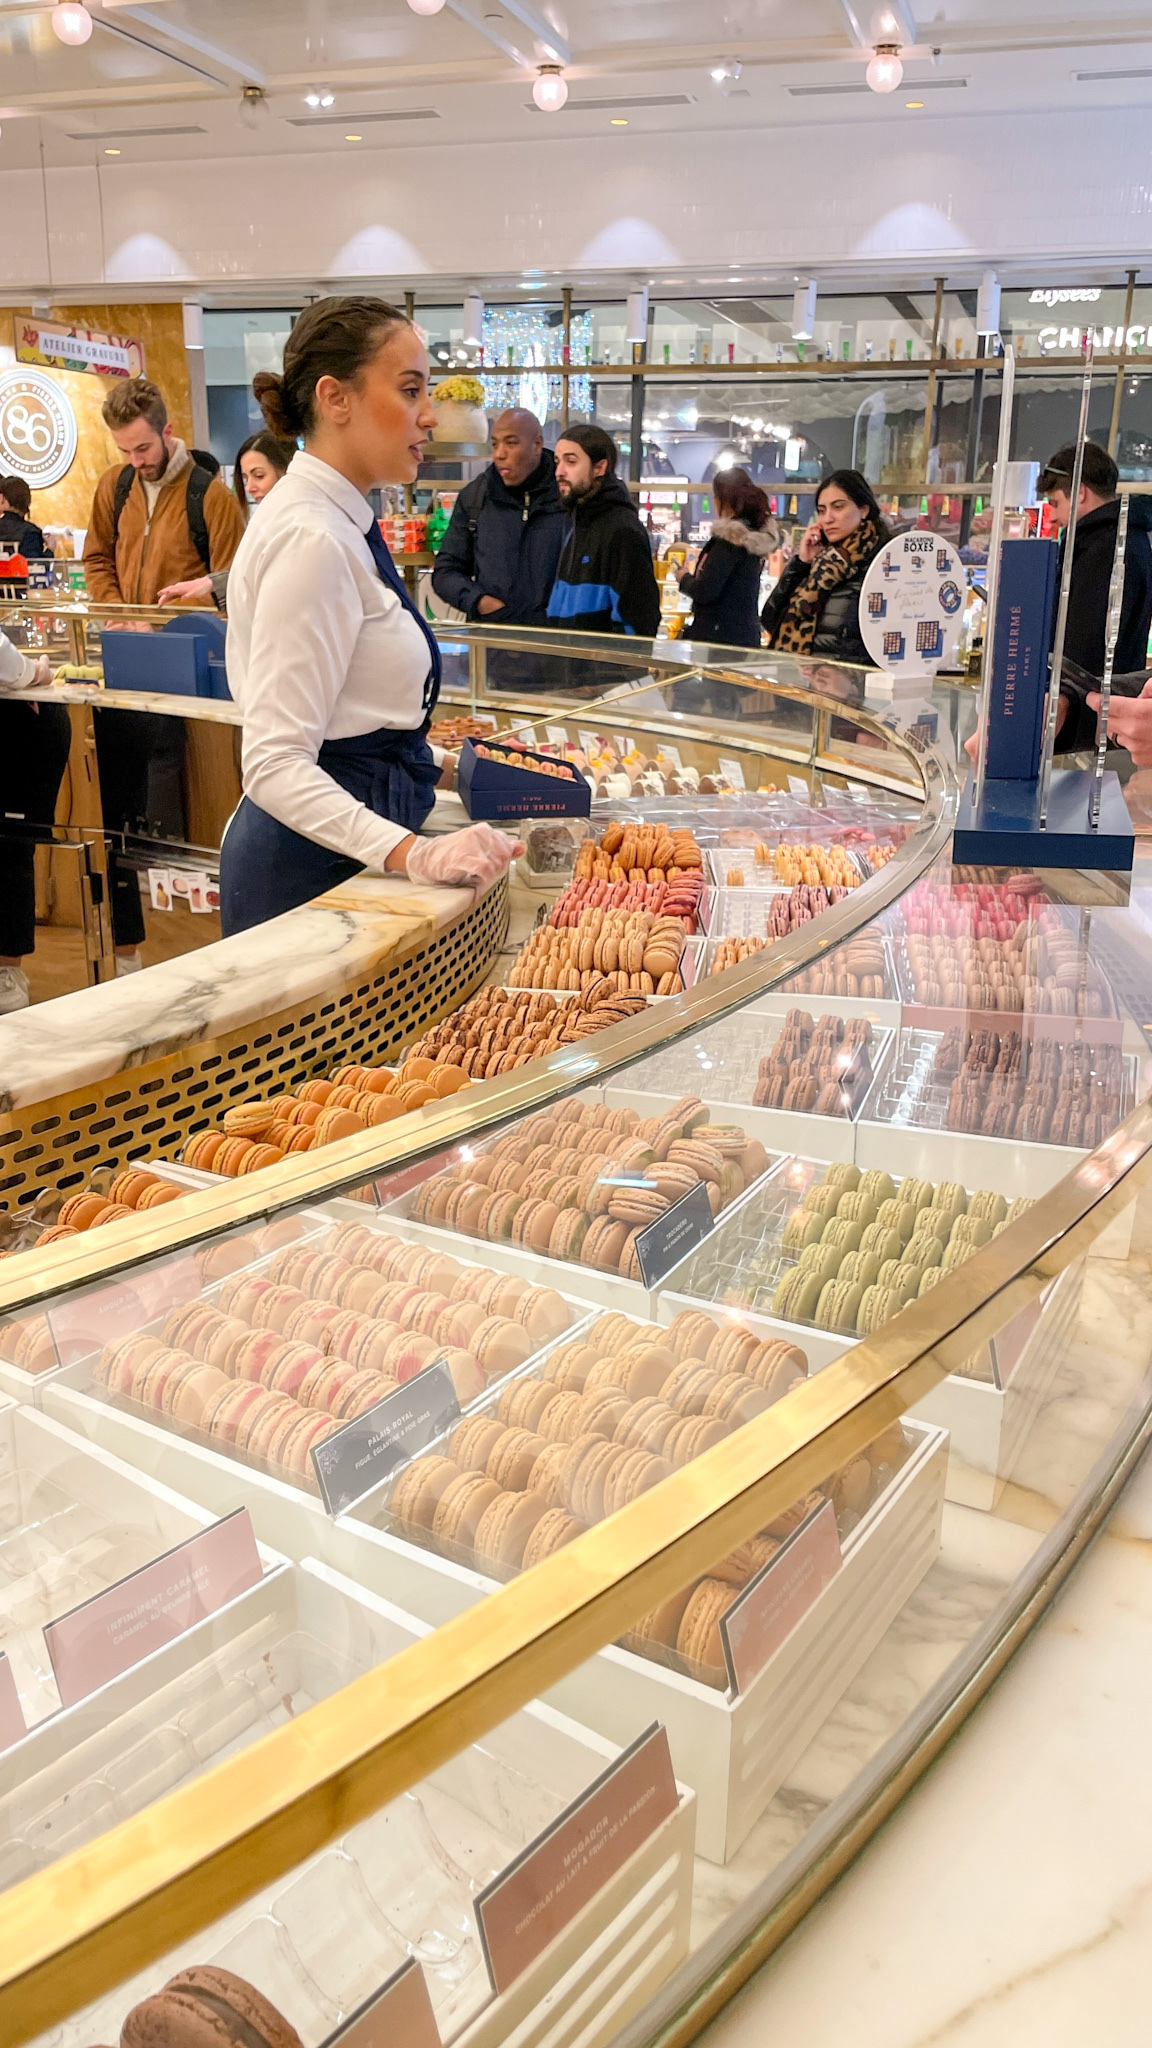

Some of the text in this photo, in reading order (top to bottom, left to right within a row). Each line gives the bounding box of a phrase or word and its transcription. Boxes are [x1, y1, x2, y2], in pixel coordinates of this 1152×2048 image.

[43, 338, 125, 363] ATELIER GRAVURE
[1038, 326, 1152, 349] CHANG
[7, 405, 51, 451] 86
[904, 543, 934, 552] BOXES
[1003, 606, 1021, 715] PIERRE HERMÉ
[1023, 646, 1032, 677] PARIS
[367, 1411, 413, 1447] PALAIS-ROYAL
[405, 1421, 417, 1433] FOIE
[416, 1410, 431, 1424] GRAS
[106, 1564, 210, 1634] INFINIMENT CARAMEL
[112, 1620, 149, 1645] CARAMEL
[149, 1612, 160, 1622] AU
[563, 1815, 609, 1867] MOGADOR
[514, 1784, 656, 1935] CHOCOLAT AU LAIT & FRUIT DE LA PASSION
